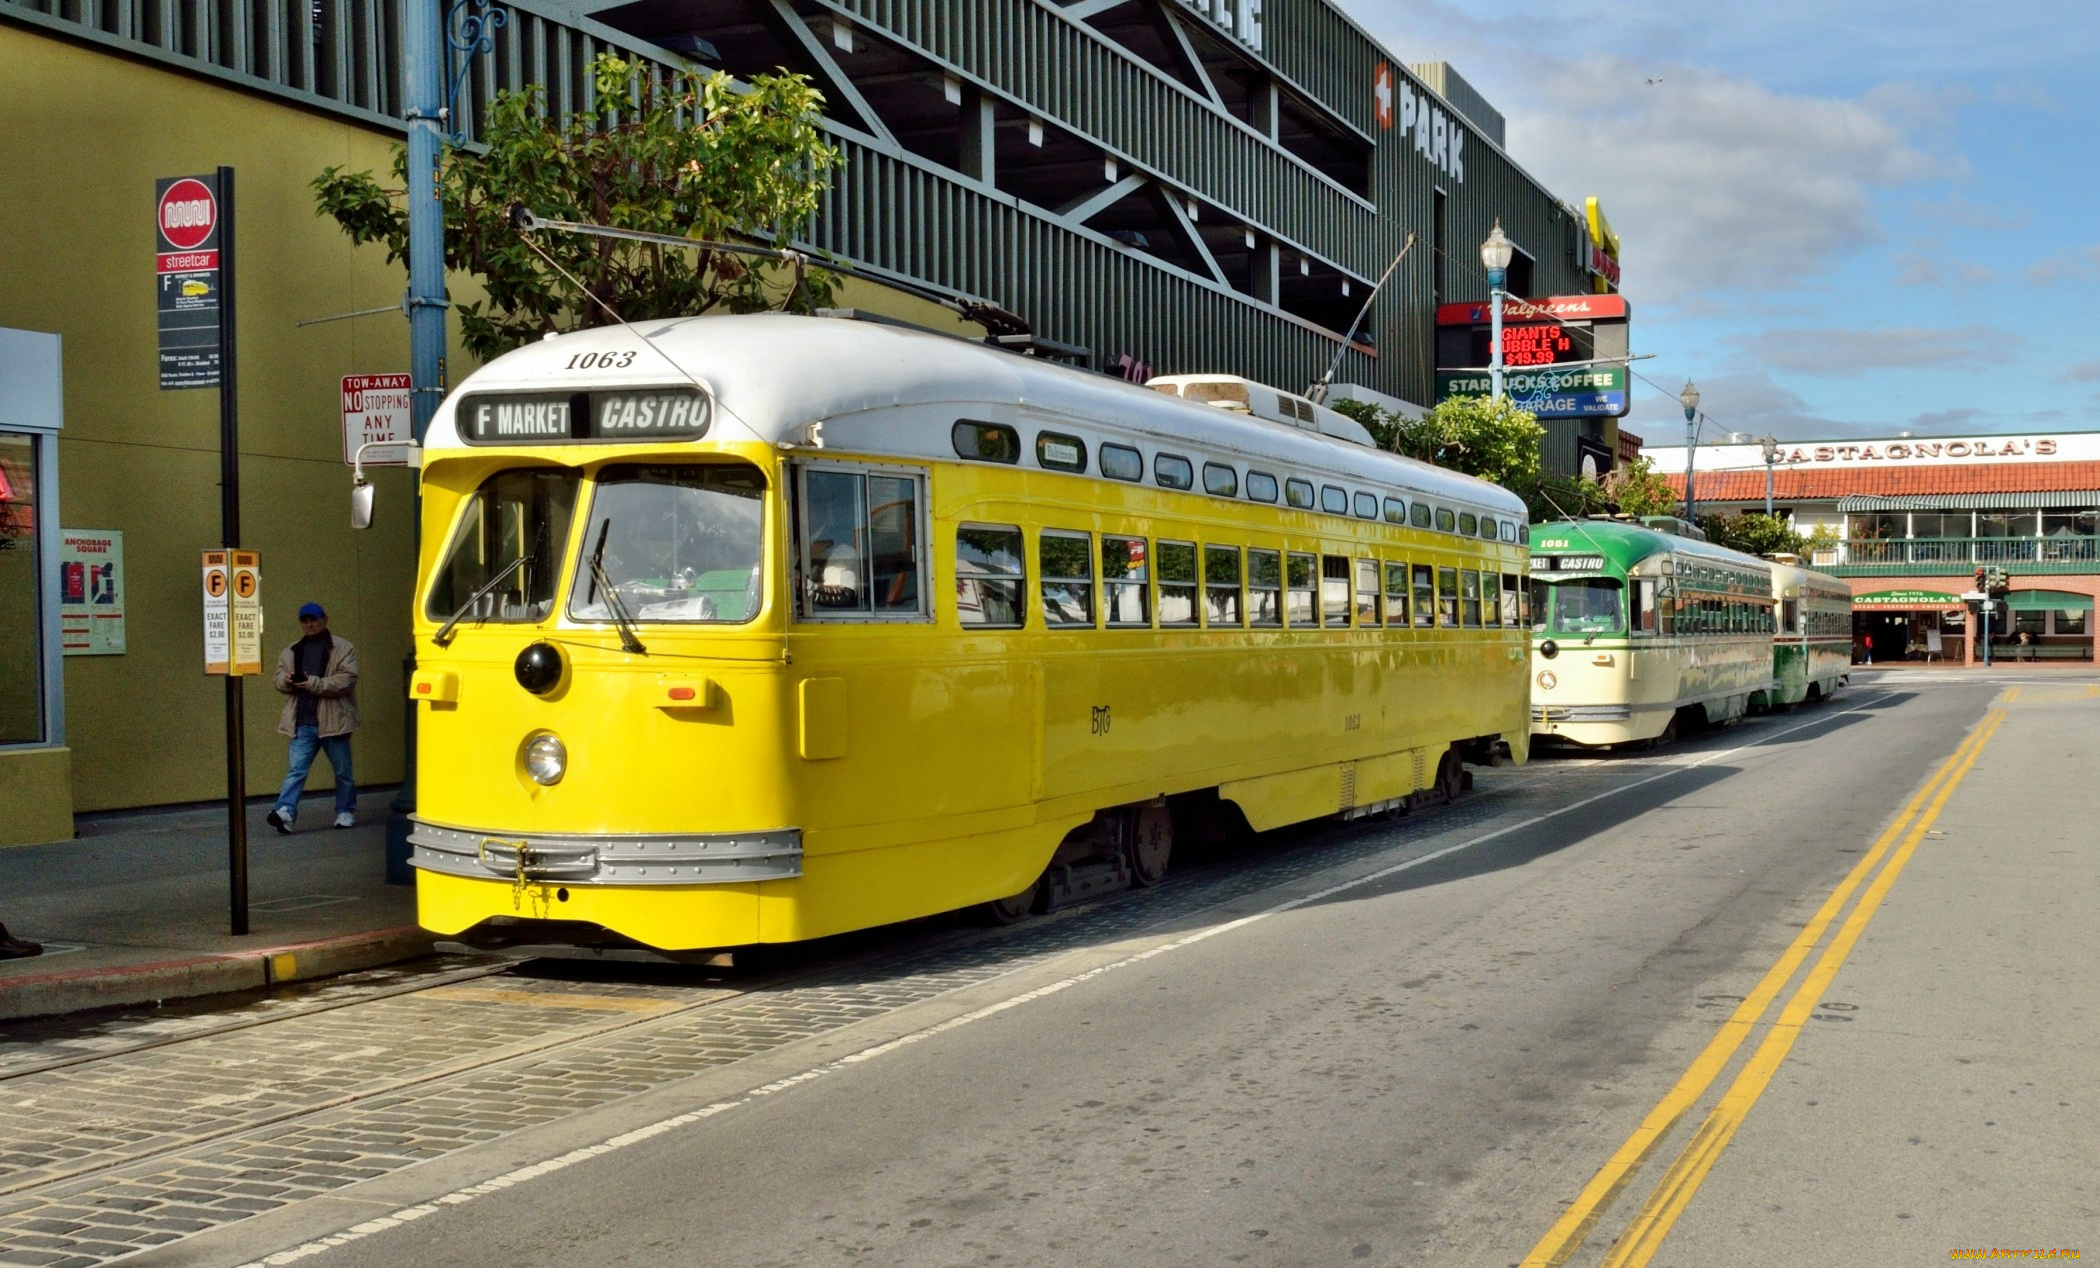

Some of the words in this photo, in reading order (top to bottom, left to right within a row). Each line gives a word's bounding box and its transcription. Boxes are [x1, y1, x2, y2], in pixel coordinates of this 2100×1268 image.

[1400, 79, 1464, 184] PARK
[166, 253, 210, 268] streetcar
[164, 274, 172, 291] F
[1502, 325, 1561, 341] GIANTS
[1558, 337, 1570, 350] H
[565, 350, 637, 370] 1063
[1506, 350, 1555, 366] $19.99
[347, 376, 407, 389] TOW-AWAY
[1448, 376, 1544, 393] STARUCKS
[1552, 373, 1613, 390] COFFEE
[344, 391, 363, 412] NO
[364, 394, 409, 410] STOPPING
[1595, 395, 1608, 403] WE
[478, 404, 491, 435] F
[498, 401, 570, 435] MARKET
[602, 394, 708, 429] CASTRO
[1583, 403, 1619, 412] VALIDATE
[364, 415, 393, 430] ANY
[1761, 439, 2057, 464] CASTAGNOLA'S
[64, 538, 112, 547] ANCHORAGE
[1541, 539, 1569, 548] 1051
[1560, 557, 1604, 570] CASTRO
[211, 575, 221, 592] F
[240, 576, 250, 593] F
[1854, 596, 1960, 604] CASTAGNOLA'S
[207, 612, 227, 621] EXACT
[235, 613, 256, 621] EXACT
[209, 621, 225, 629] FARE
[238, 622, 254, 630] FARE
